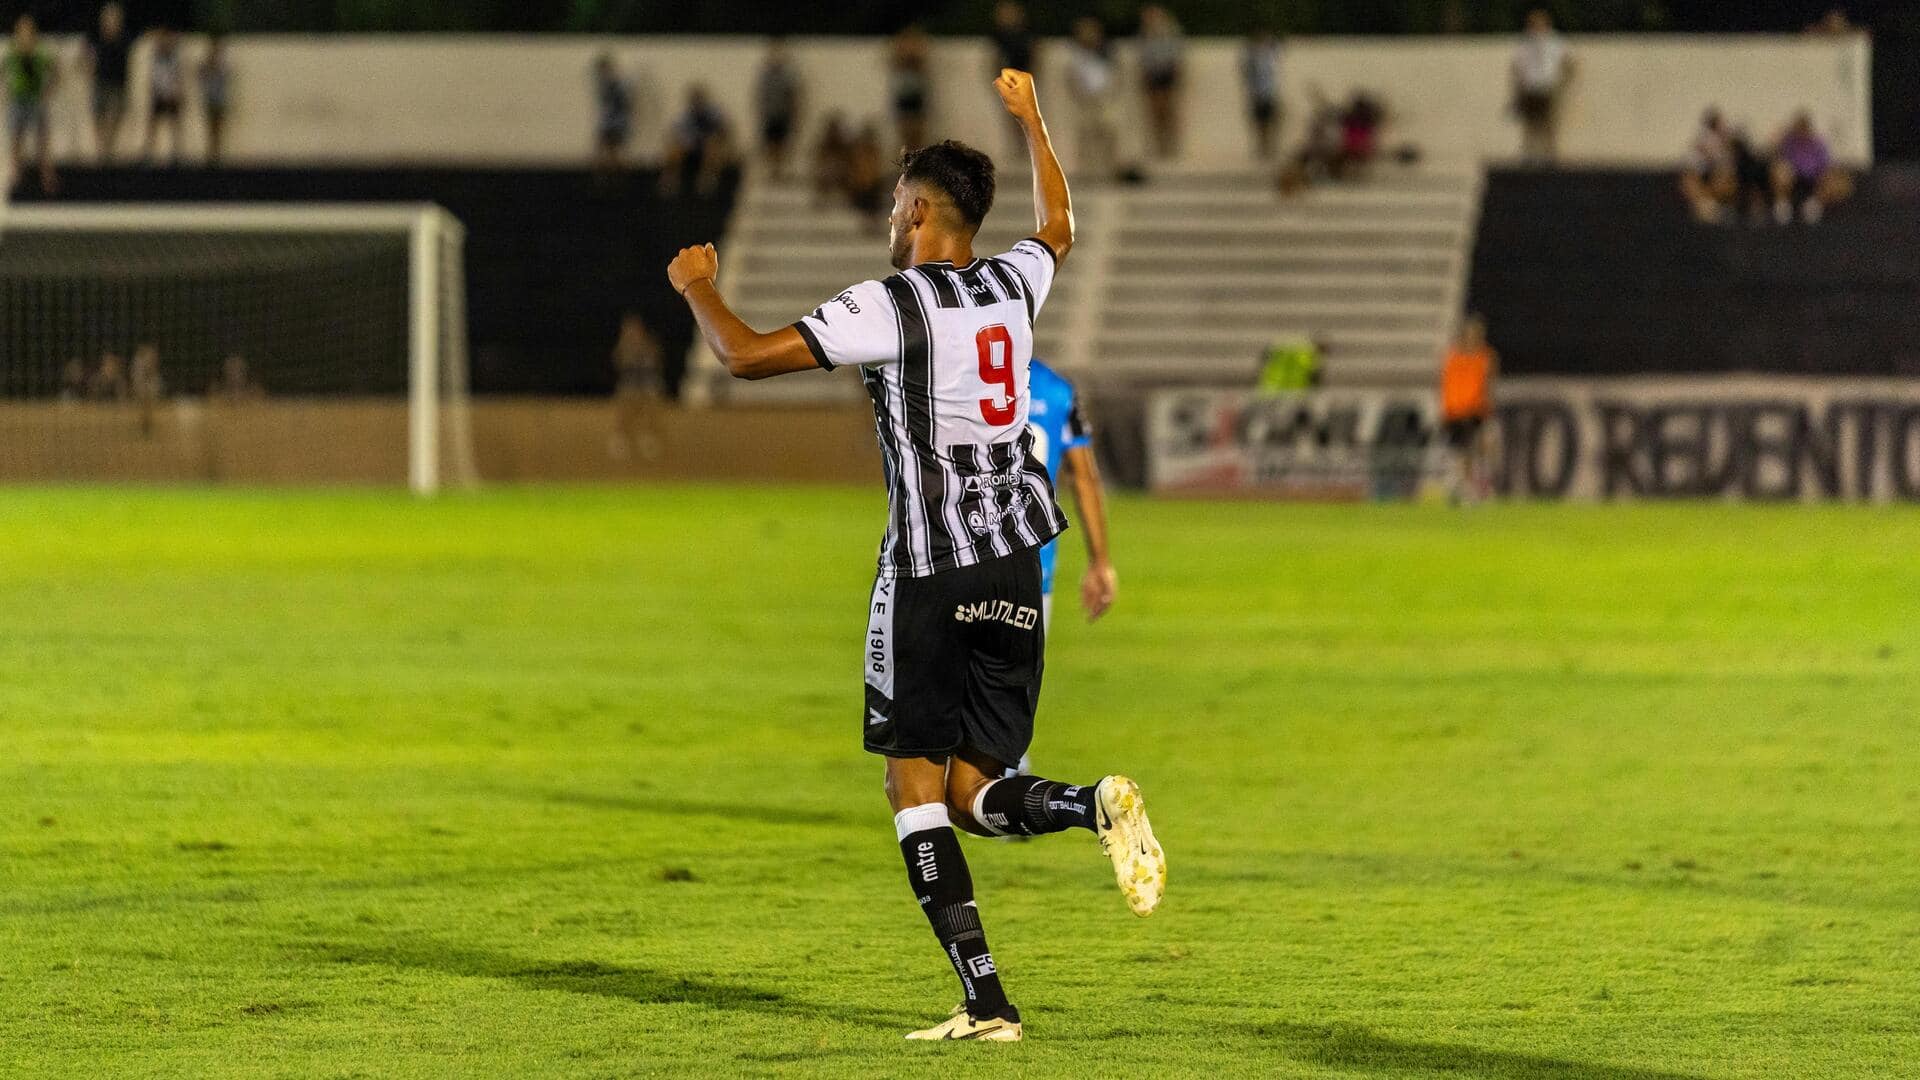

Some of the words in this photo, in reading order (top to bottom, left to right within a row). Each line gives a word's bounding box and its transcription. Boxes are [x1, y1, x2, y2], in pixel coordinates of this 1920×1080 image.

[975, 323, 1016, 427] 9
[872, 602, 886, 615] E
[970, 599, 1038, 631] MUTILED
[870, 627, 885, 674] 1908
[916, 841, 939, 883] mitre
